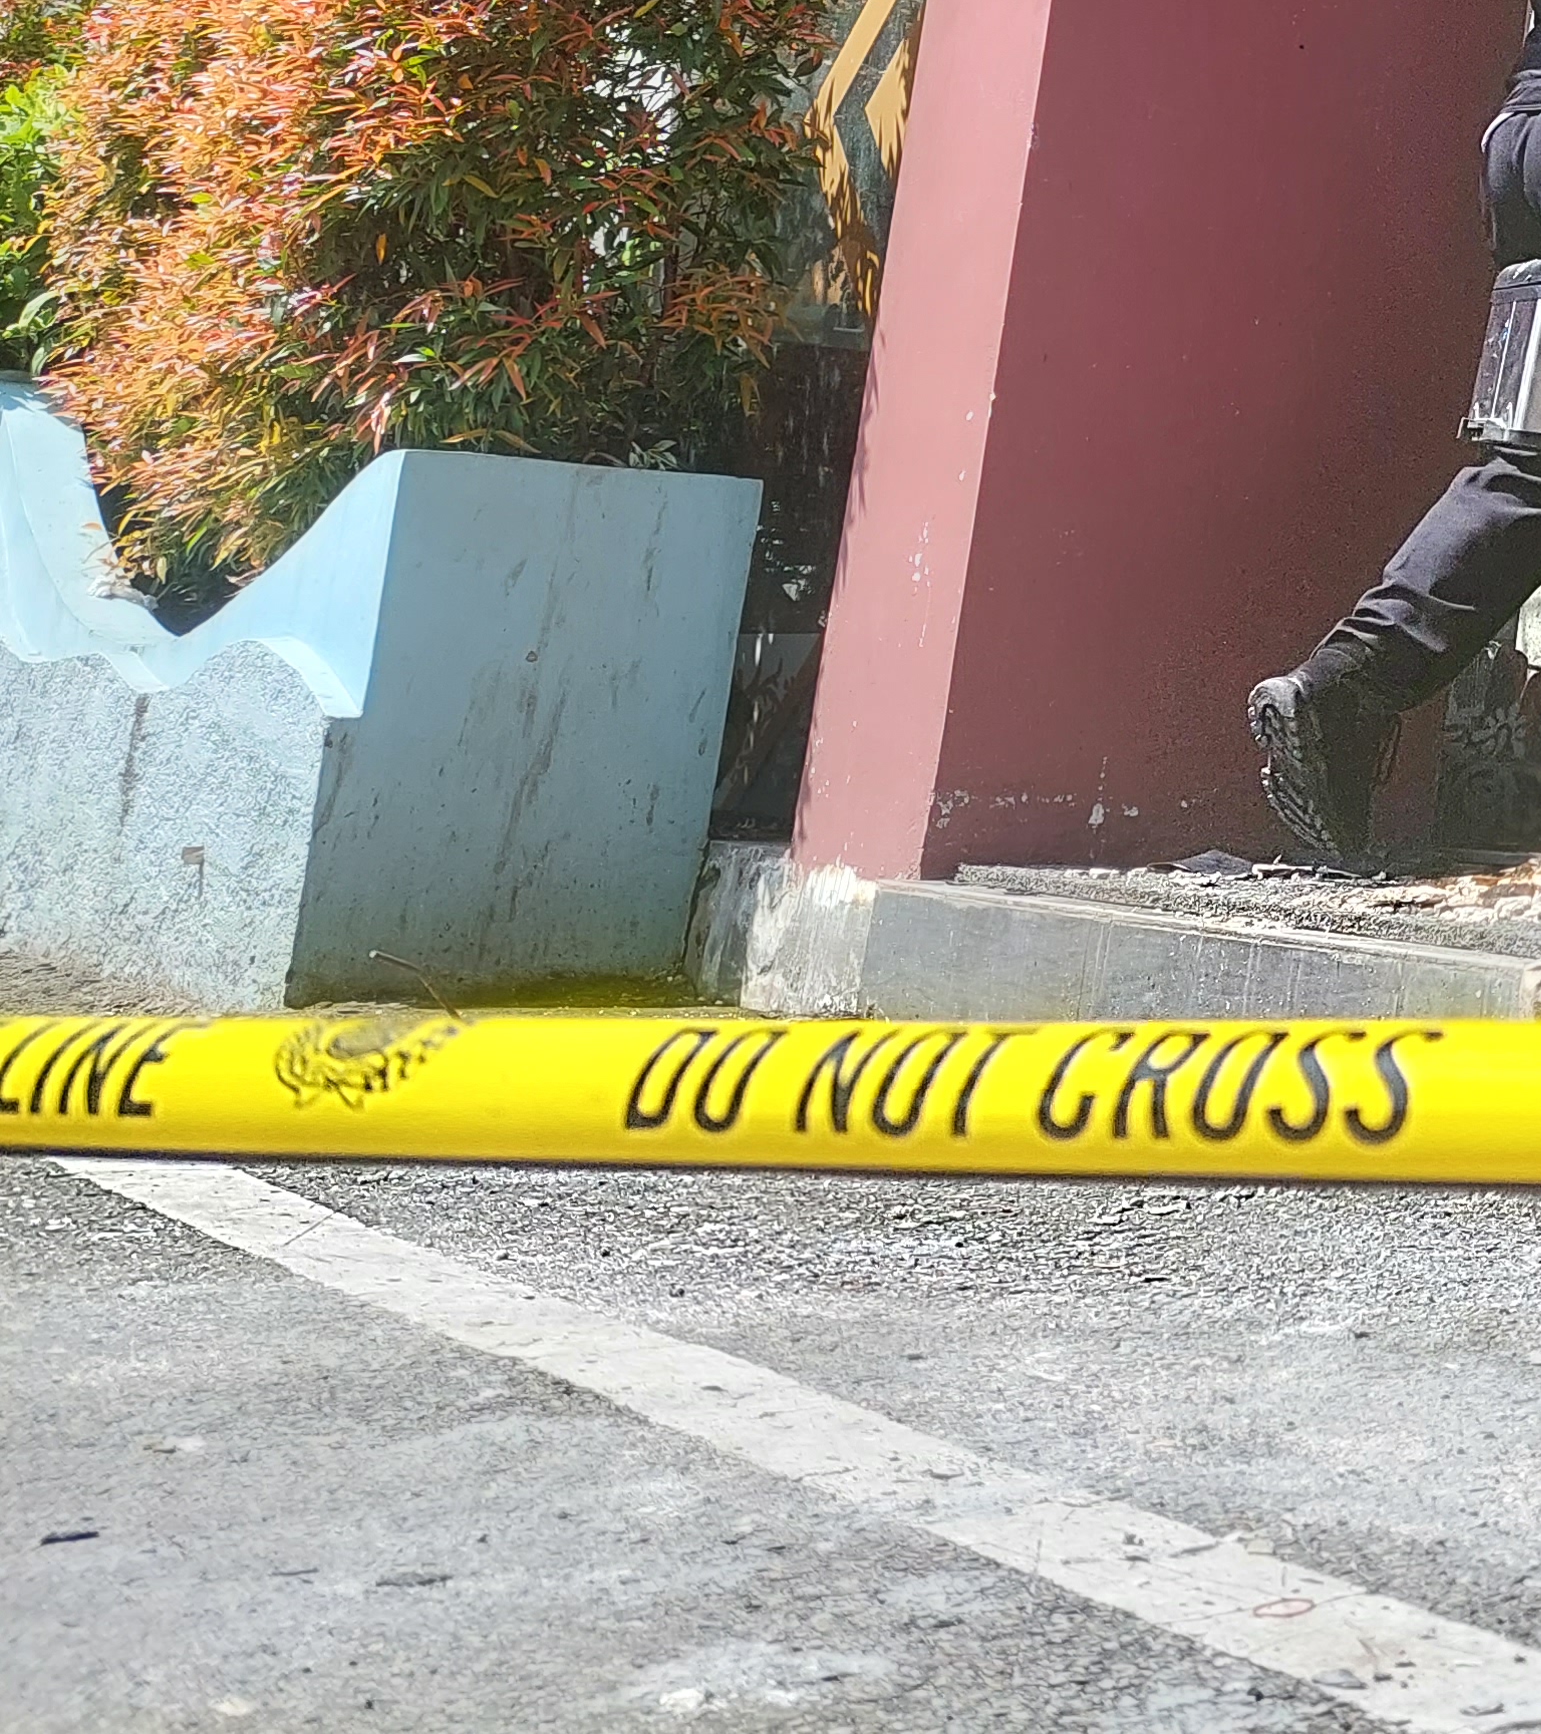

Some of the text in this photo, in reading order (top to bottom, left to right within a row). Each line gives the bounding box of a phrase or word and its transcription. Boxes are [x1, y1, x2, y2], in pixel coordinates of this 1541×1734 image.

[625, 1028, 1444, 1145] DO NOT CROSS
